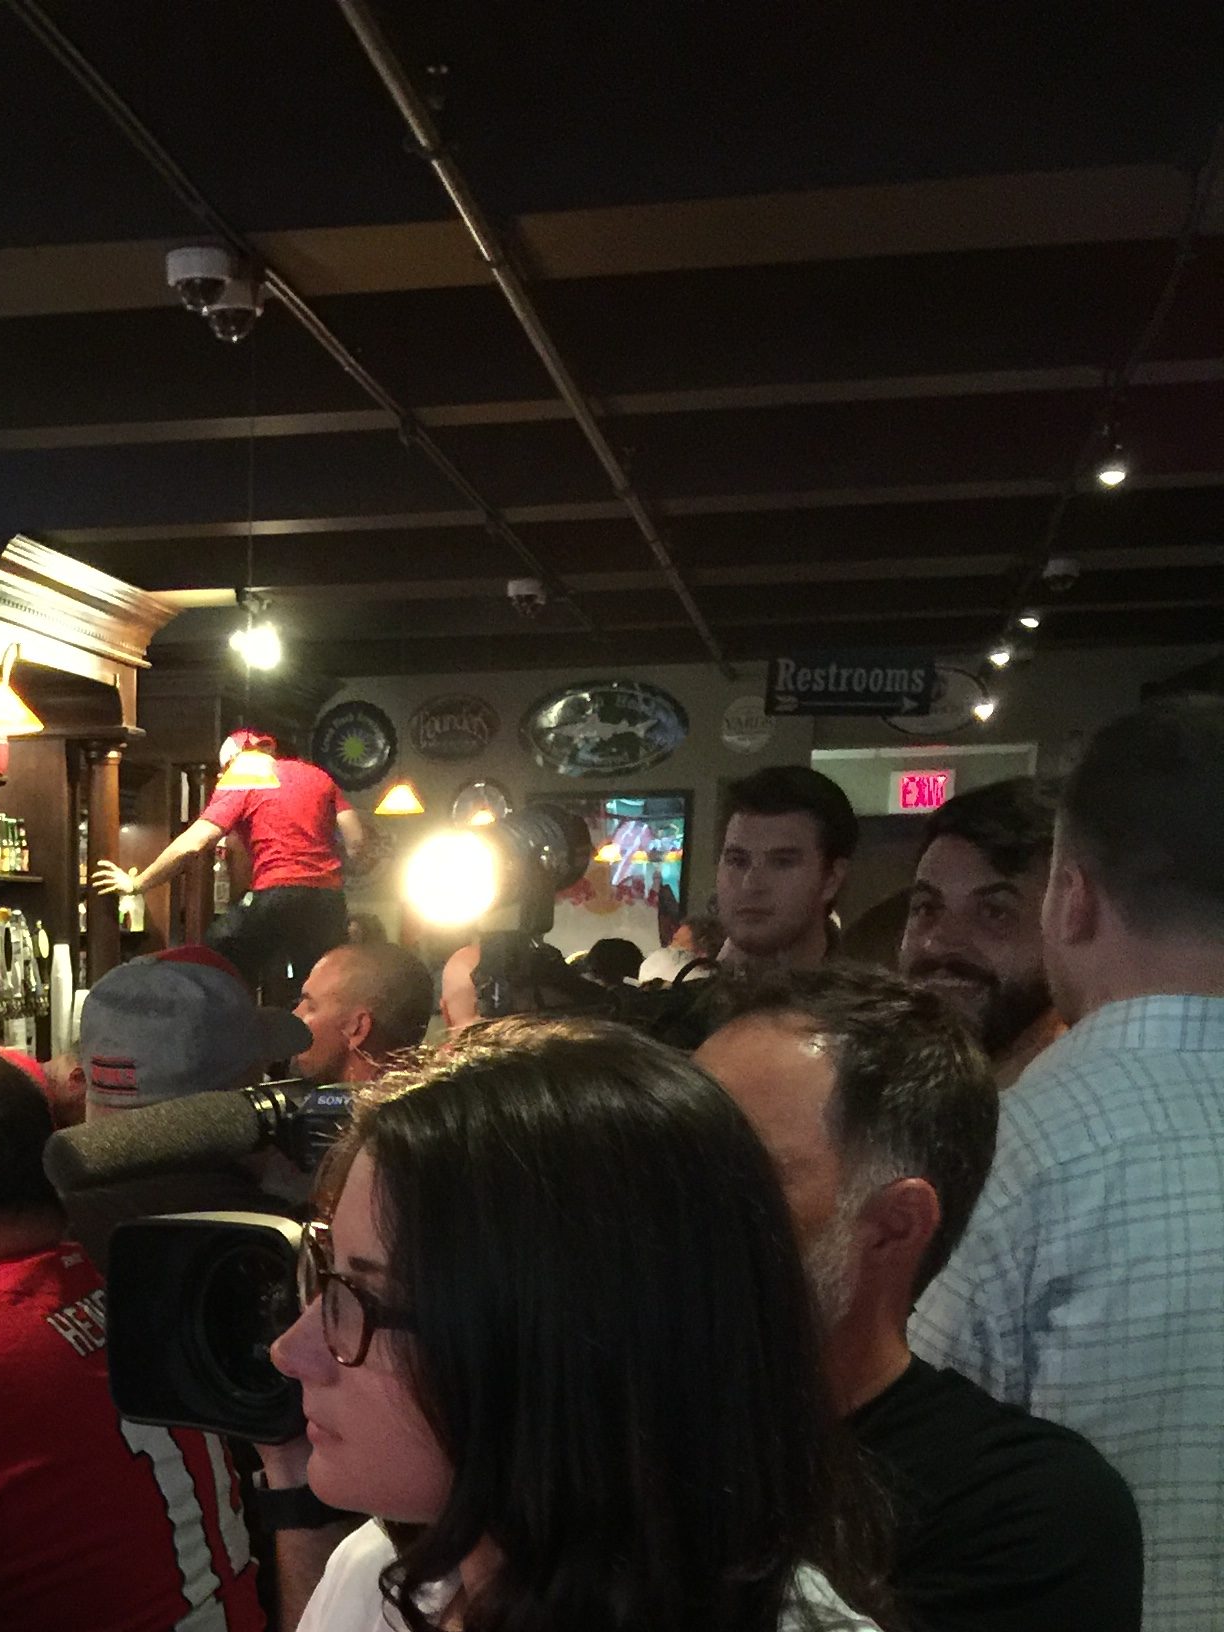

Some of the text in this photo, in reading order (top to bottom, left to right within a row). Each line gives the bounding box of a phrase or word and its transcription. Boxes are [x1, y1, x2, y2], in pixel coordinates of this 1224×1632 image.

[776, 658, 925, 693] Restrooms
[901, 775, 948, 808] EXIT
[317, 1095, 351, 1105] SONY
